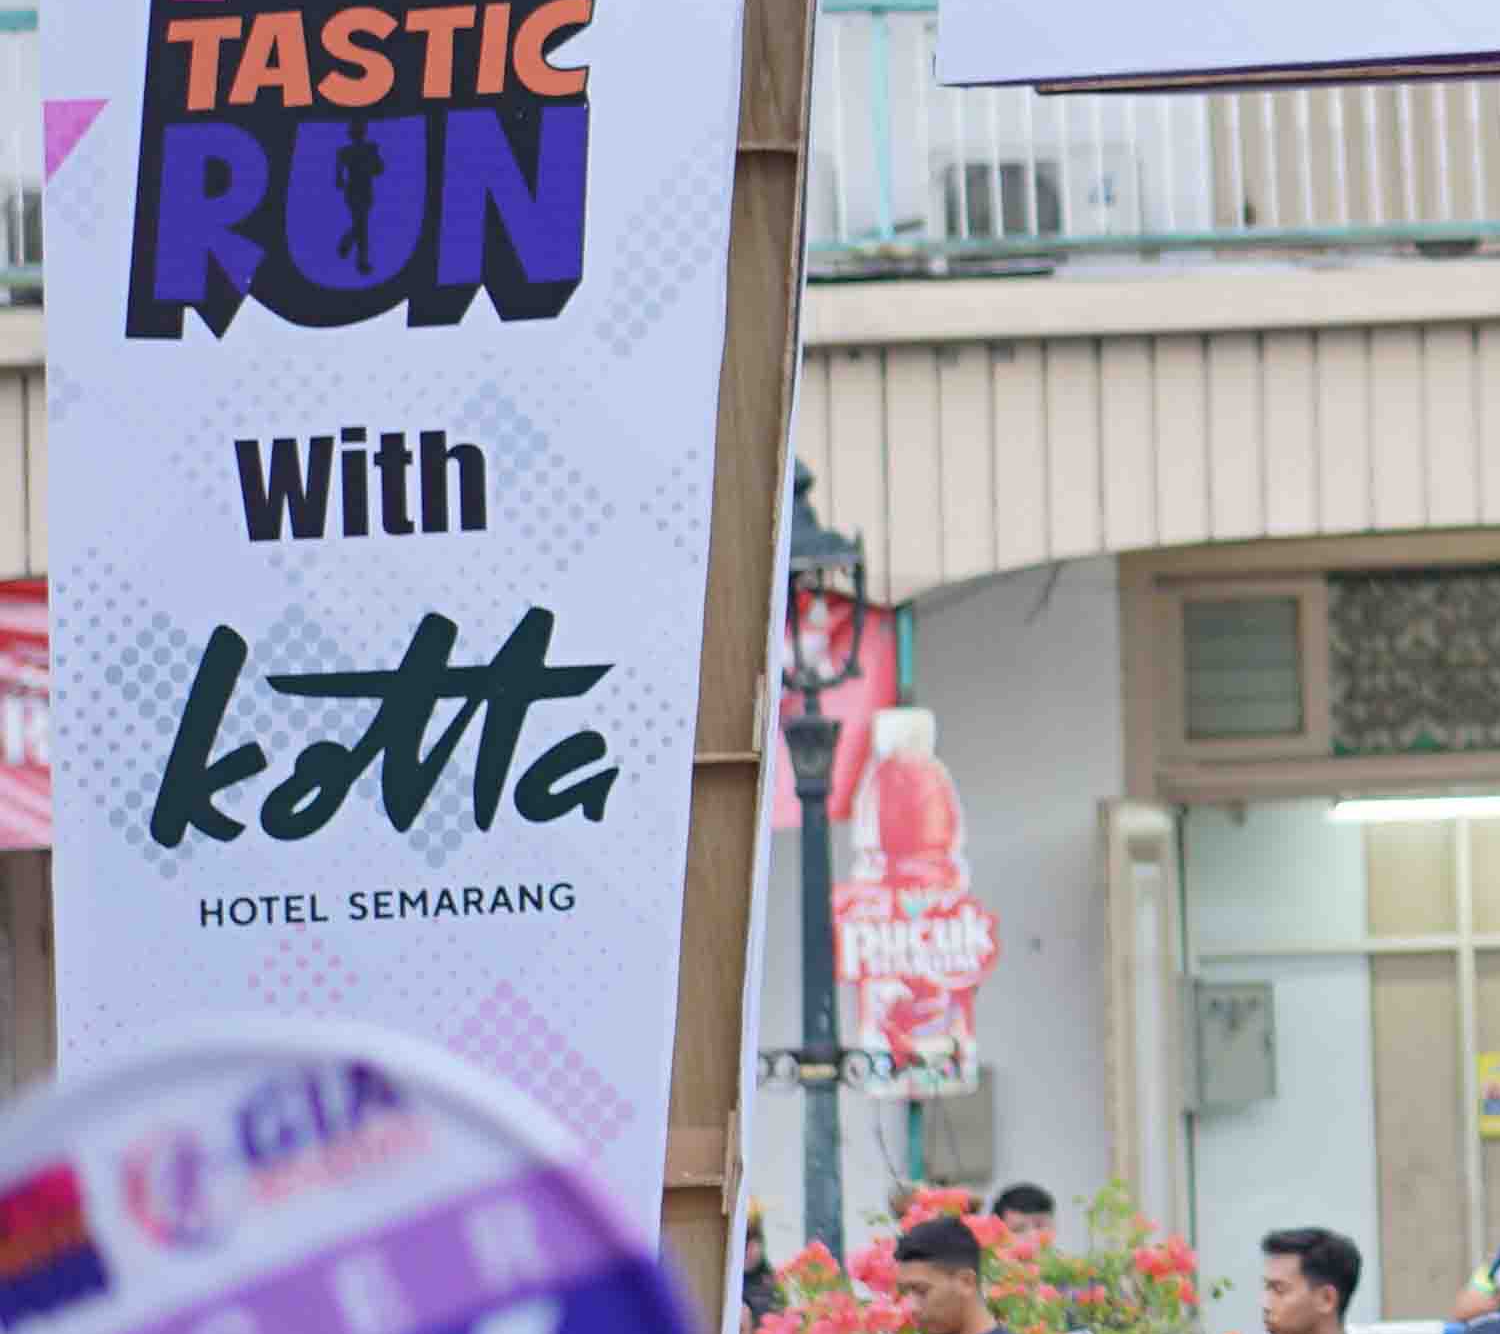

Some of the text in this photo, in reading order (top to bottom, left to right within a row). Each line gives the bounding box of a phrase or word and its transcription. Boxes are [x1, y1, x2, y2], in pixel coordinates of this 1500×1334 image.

[150, 105, 590, 302] RUN
[234, 425, 489, 542] With
[150, 605, 620, 849] kotta
[200, 882, 577, 927] HOTEL SEMARANG
